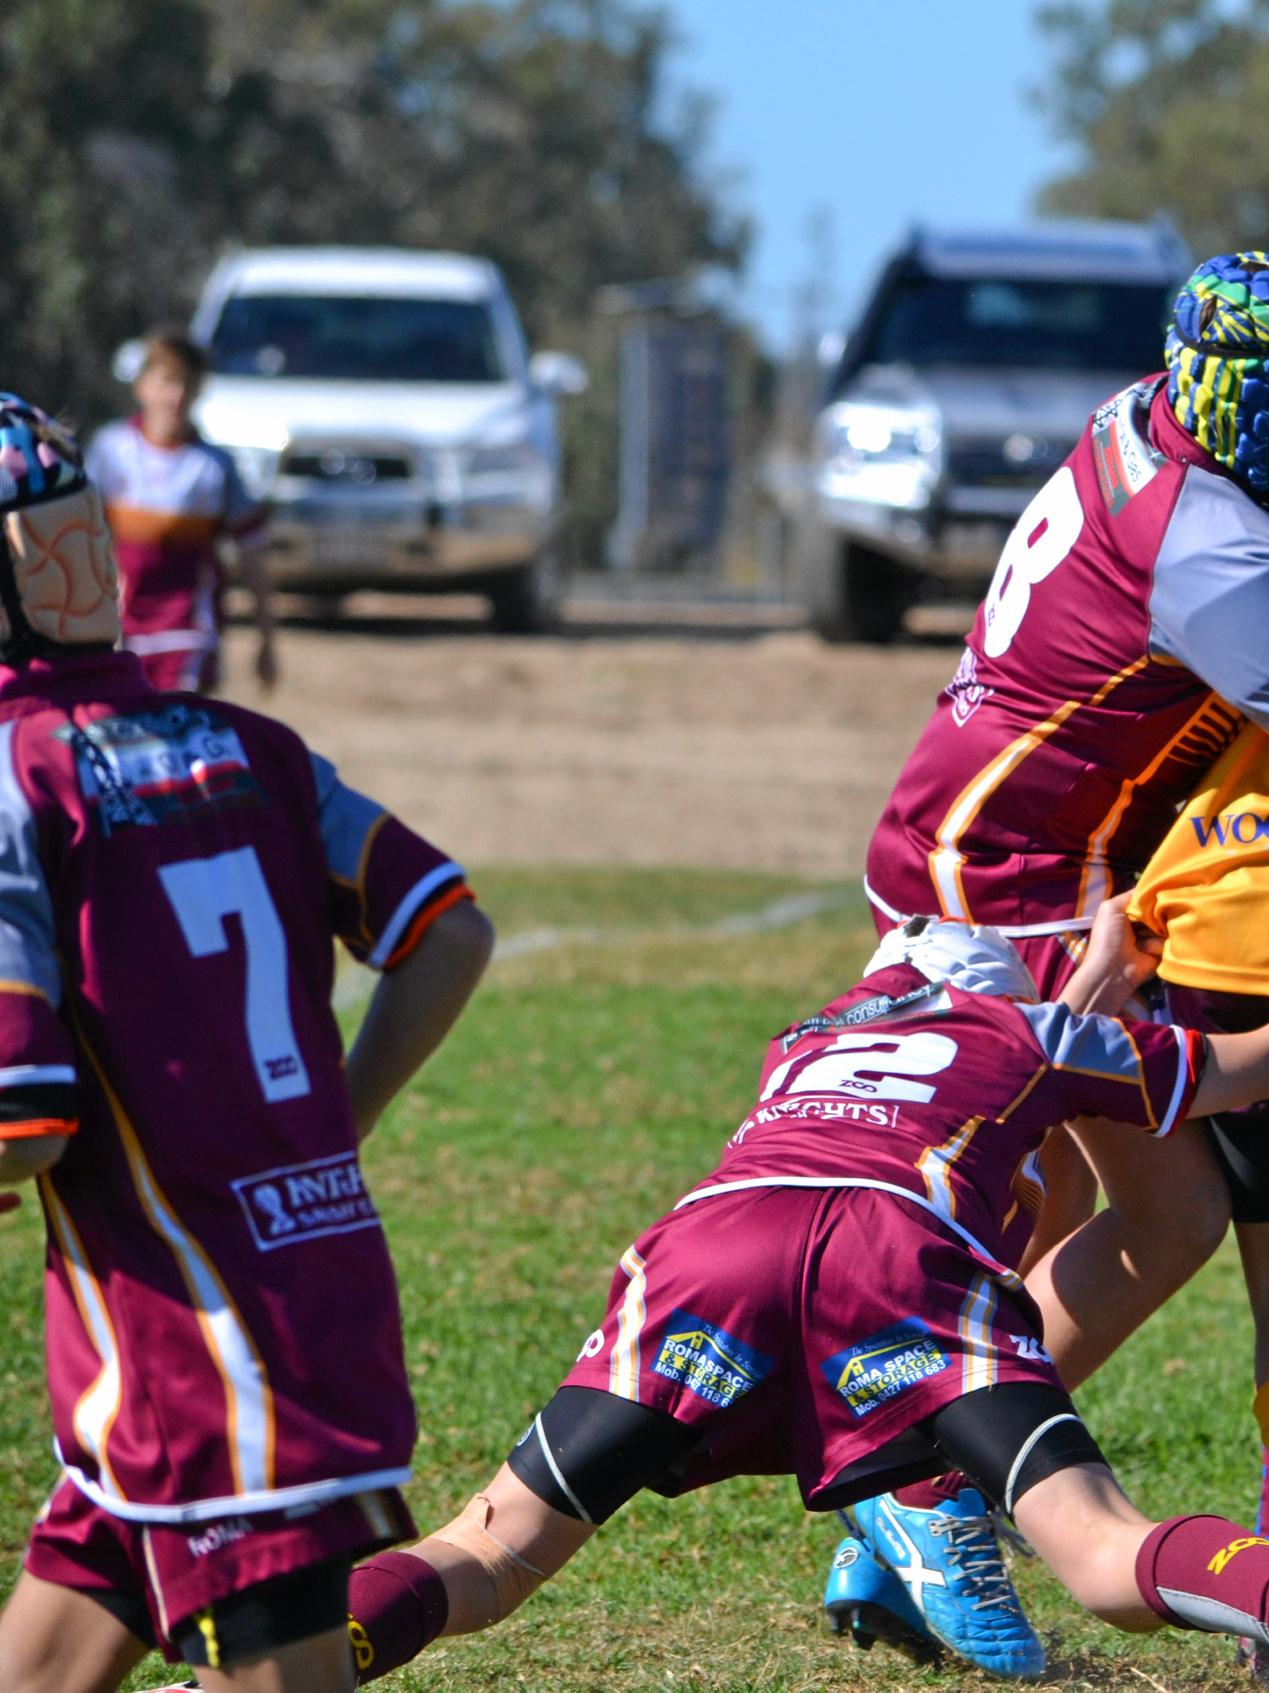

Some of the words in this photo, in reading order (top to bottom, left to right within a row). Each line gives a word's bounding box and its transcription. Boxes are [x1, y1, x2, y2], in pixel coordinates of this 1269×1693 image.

[984, 466, 1085, 658] 8
[158, 845, 310, 1103] 7
[760, 1031, 959, 1104] 12
[701, 1386, 721, 1403] 118
[840, 1367, 883, 1397] ROMA
[884, 1339, 936, 1372] SPACE
[902, 1369, 924, 1386] 118
[924, 1358, 946, 1376] 683
